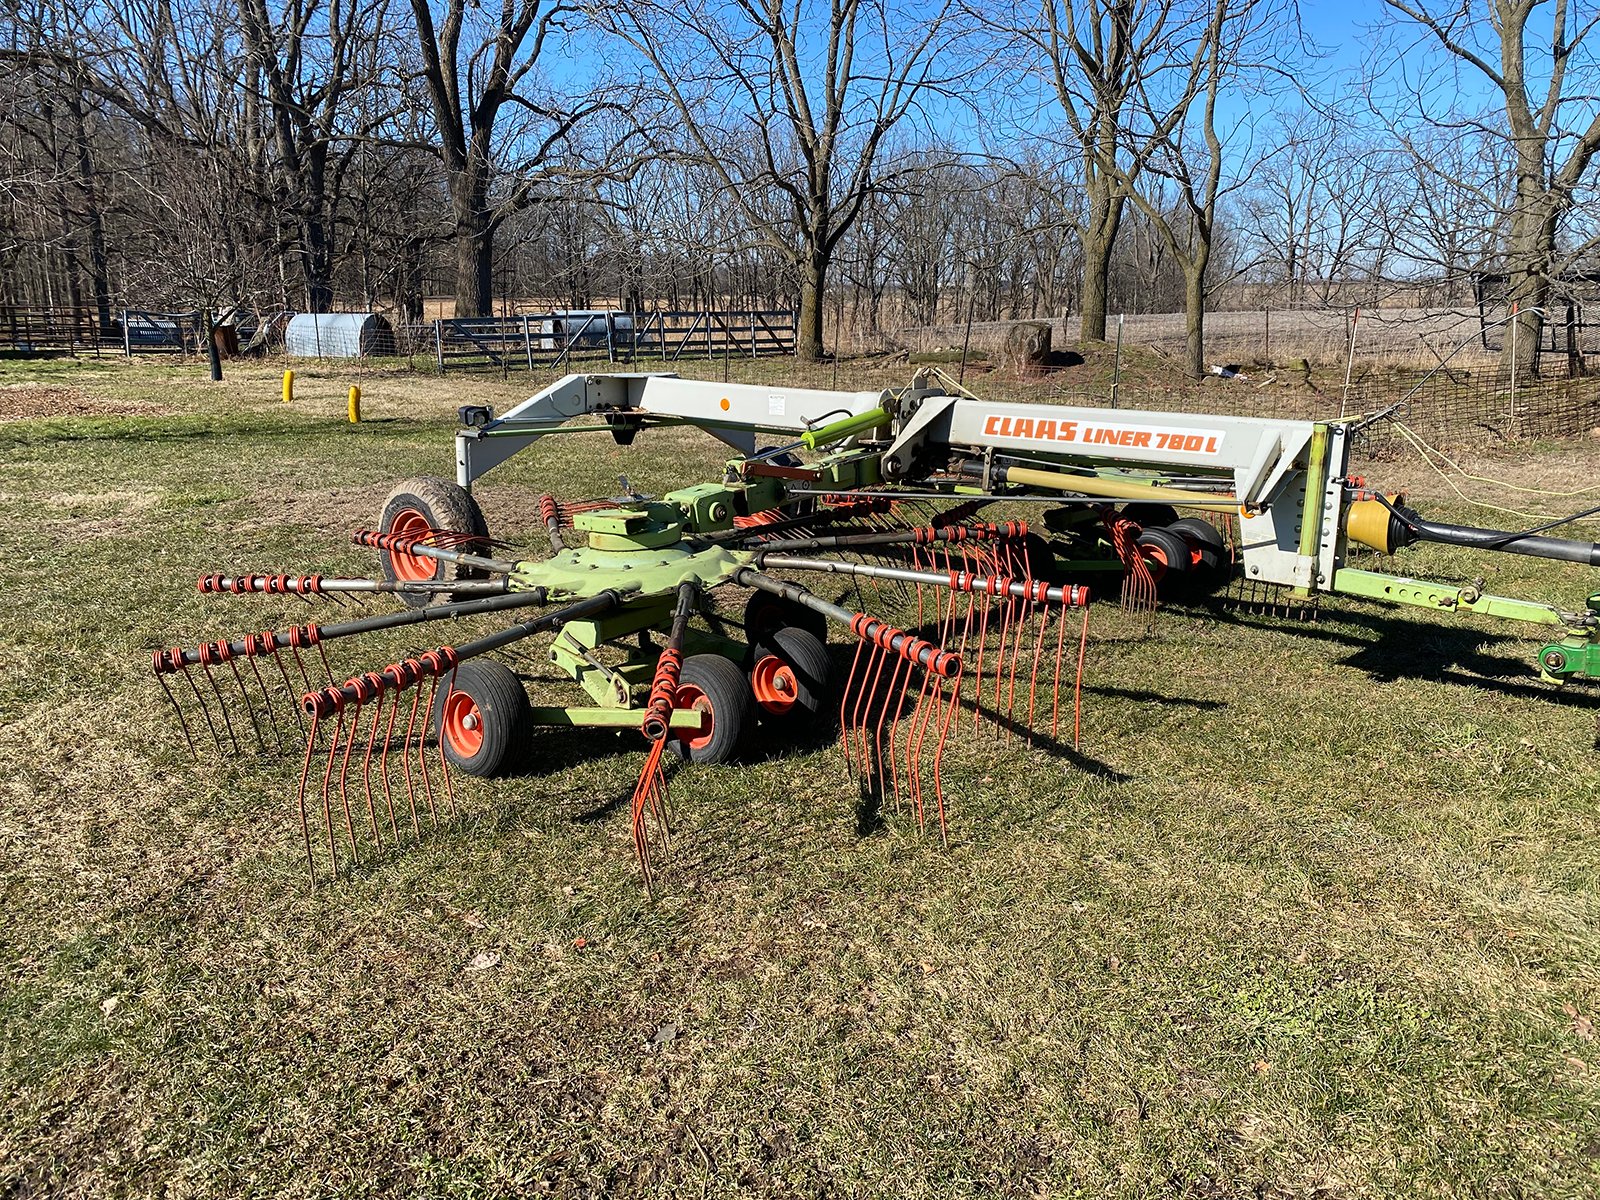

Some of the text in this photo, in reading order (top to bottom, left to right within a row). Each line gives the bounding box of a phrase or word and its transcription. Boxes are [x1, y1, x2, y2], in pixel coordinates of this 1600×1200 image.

[984, 416, 1218, 453] CLAAS LINER 780 L
